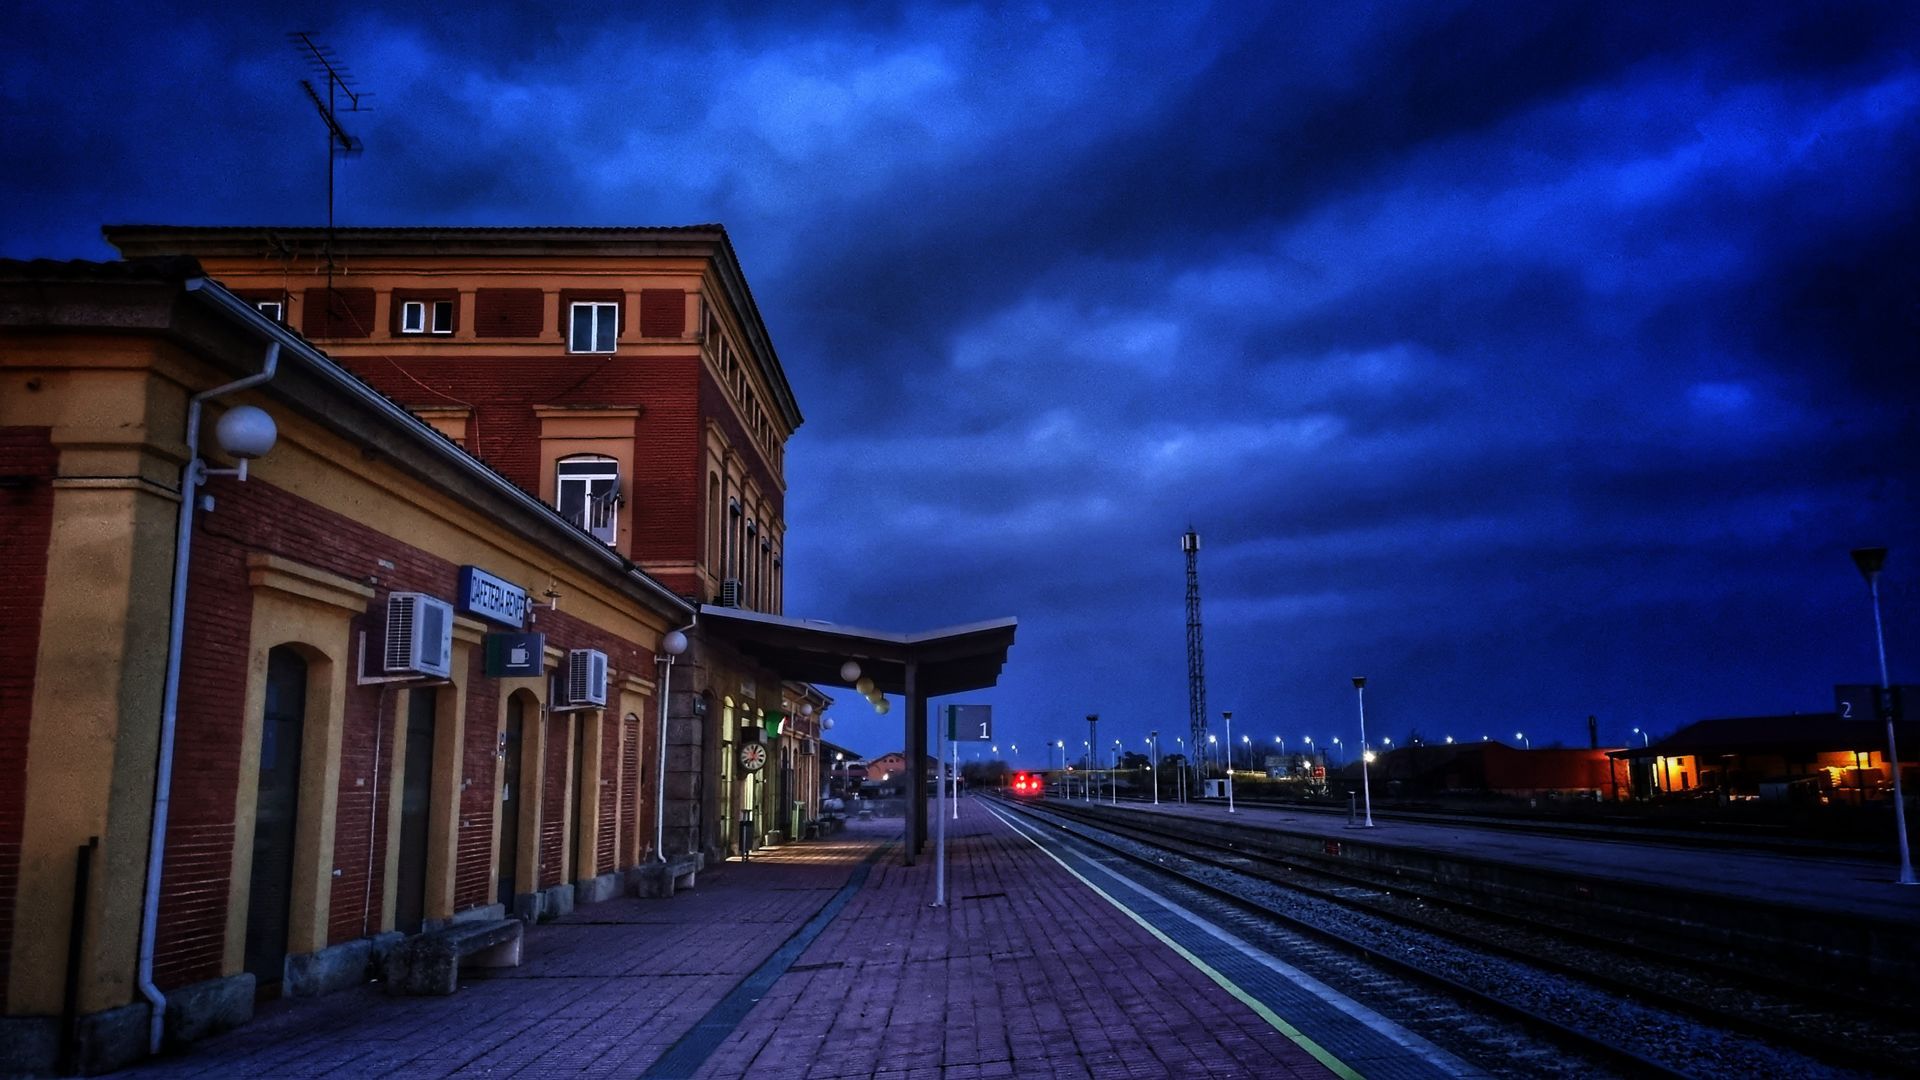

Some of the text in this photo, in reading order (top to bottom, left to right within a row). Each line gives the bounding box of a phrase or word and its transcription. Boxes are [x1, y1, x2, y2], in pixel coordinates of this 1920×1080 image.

[471, 576, 524, 620] CAFETERIA RENFE
[1840, 701, 1853, 718] 2
[979, 721, 990, 739] 1
